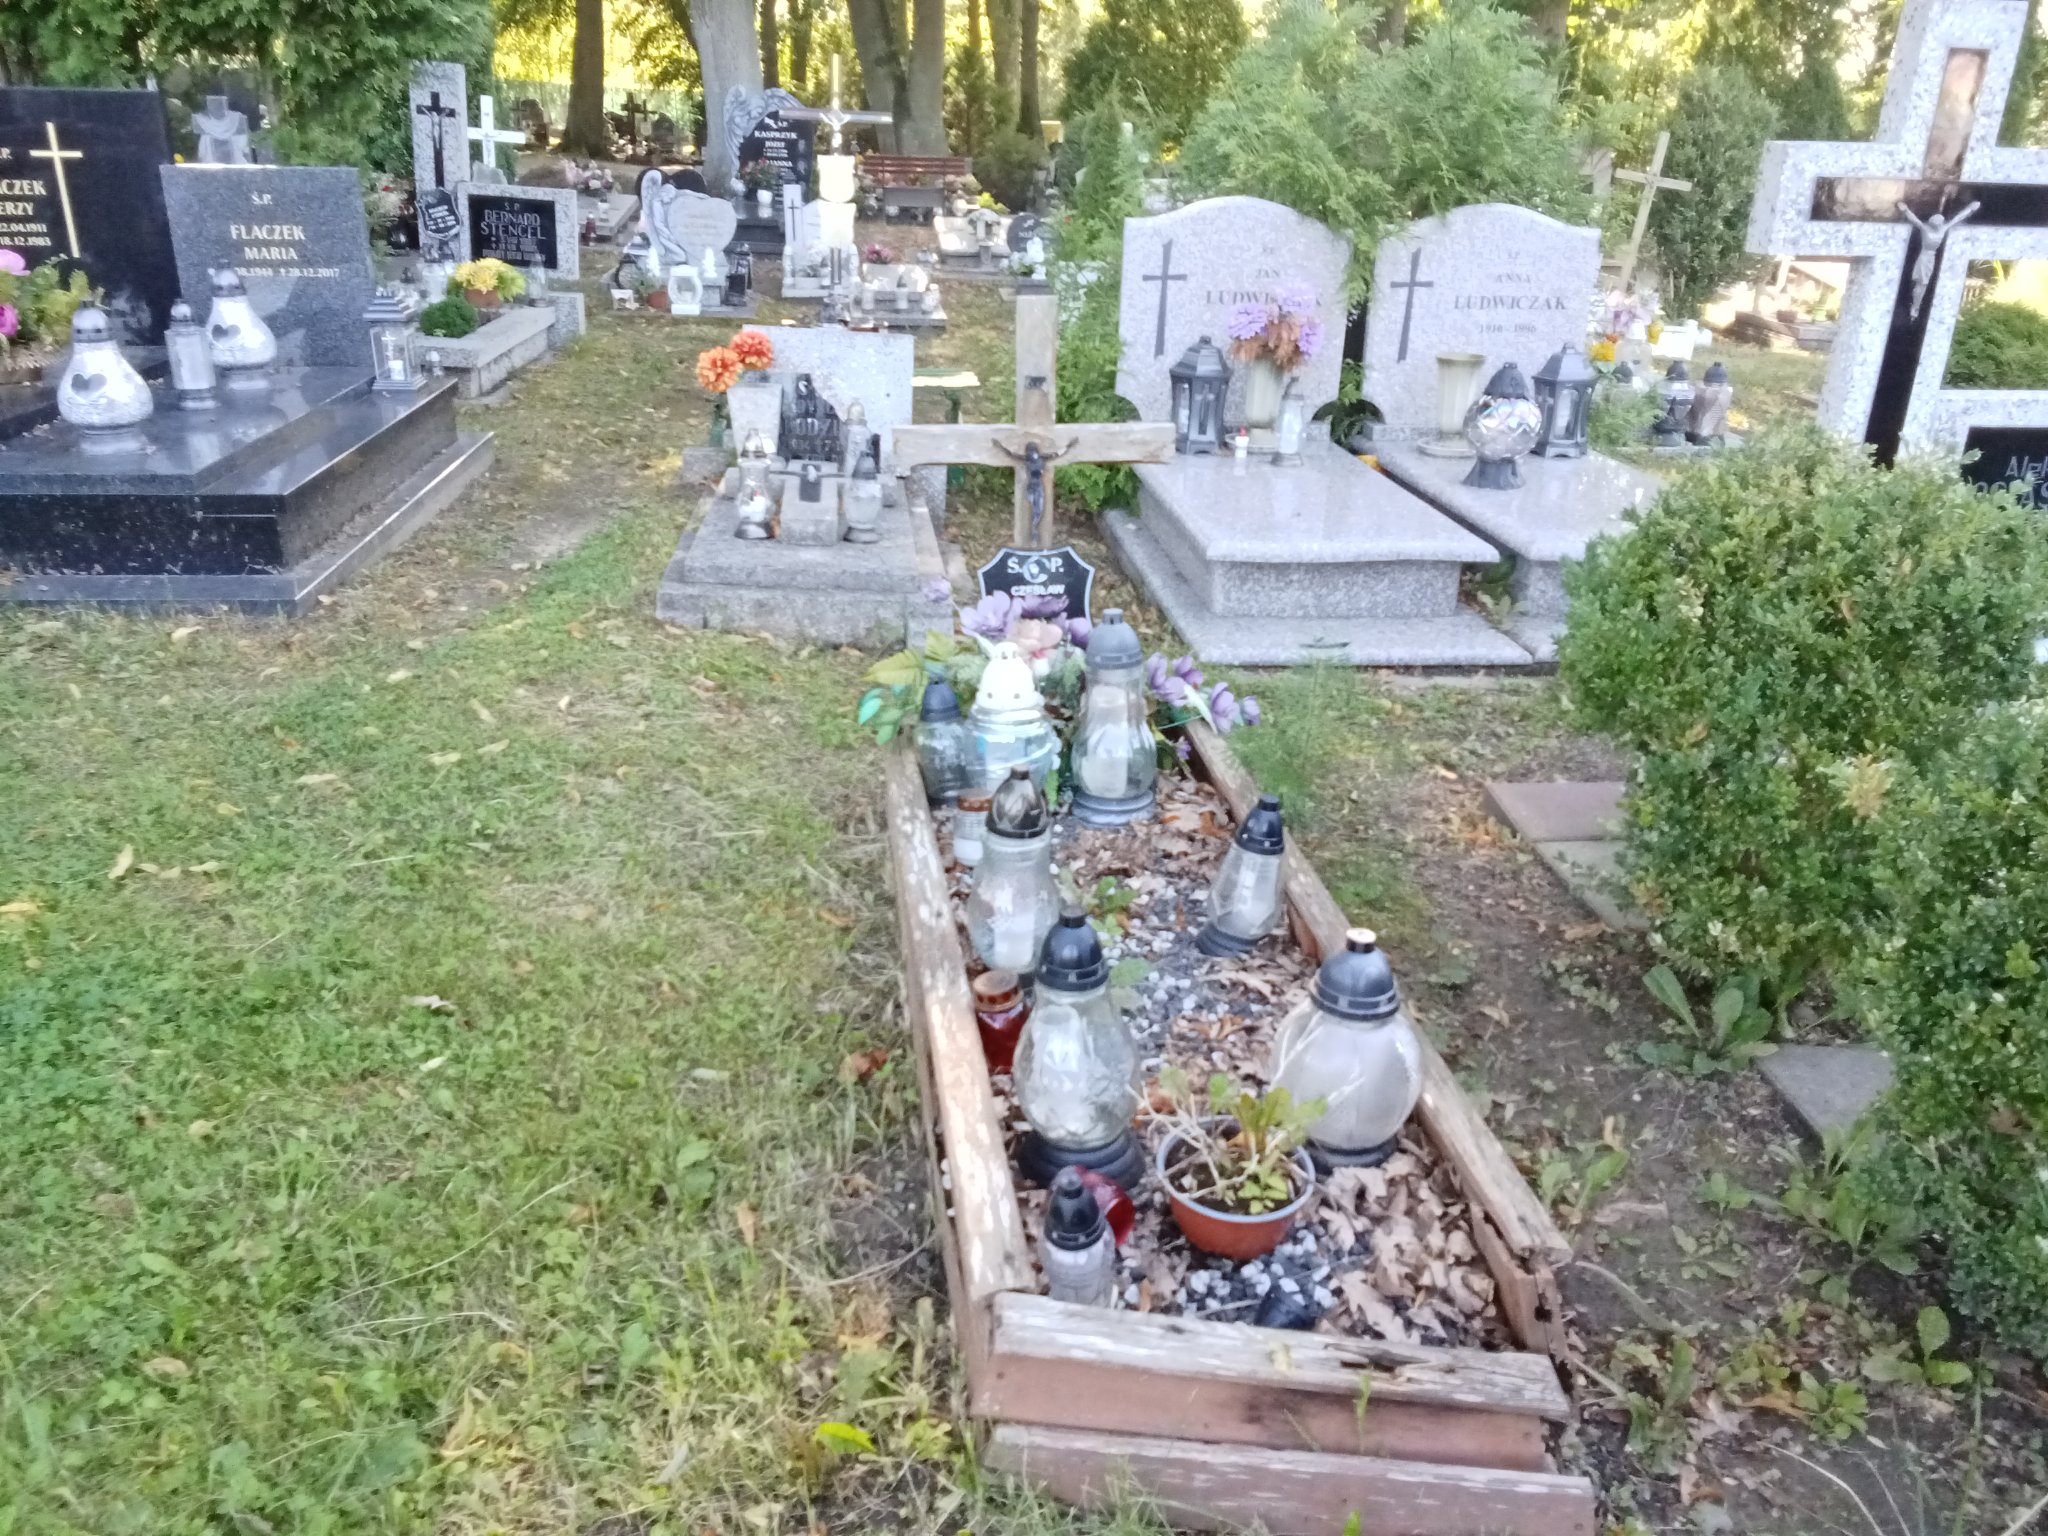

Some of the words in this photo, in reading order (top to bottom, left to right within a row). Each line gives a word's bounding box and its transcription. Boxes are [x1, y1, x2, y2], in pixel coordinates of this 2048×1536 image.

[754, 130, 797, 139] KASPRZYK
[0, 179, 46, 195] CZEK
[484, 209, 540, 225] BERNARD
[230, 224, 305, 240] FLACZEK
[244, 247, 298, 260] MARIA
[1454, 295, 1566, 310] LUDWICZAK
